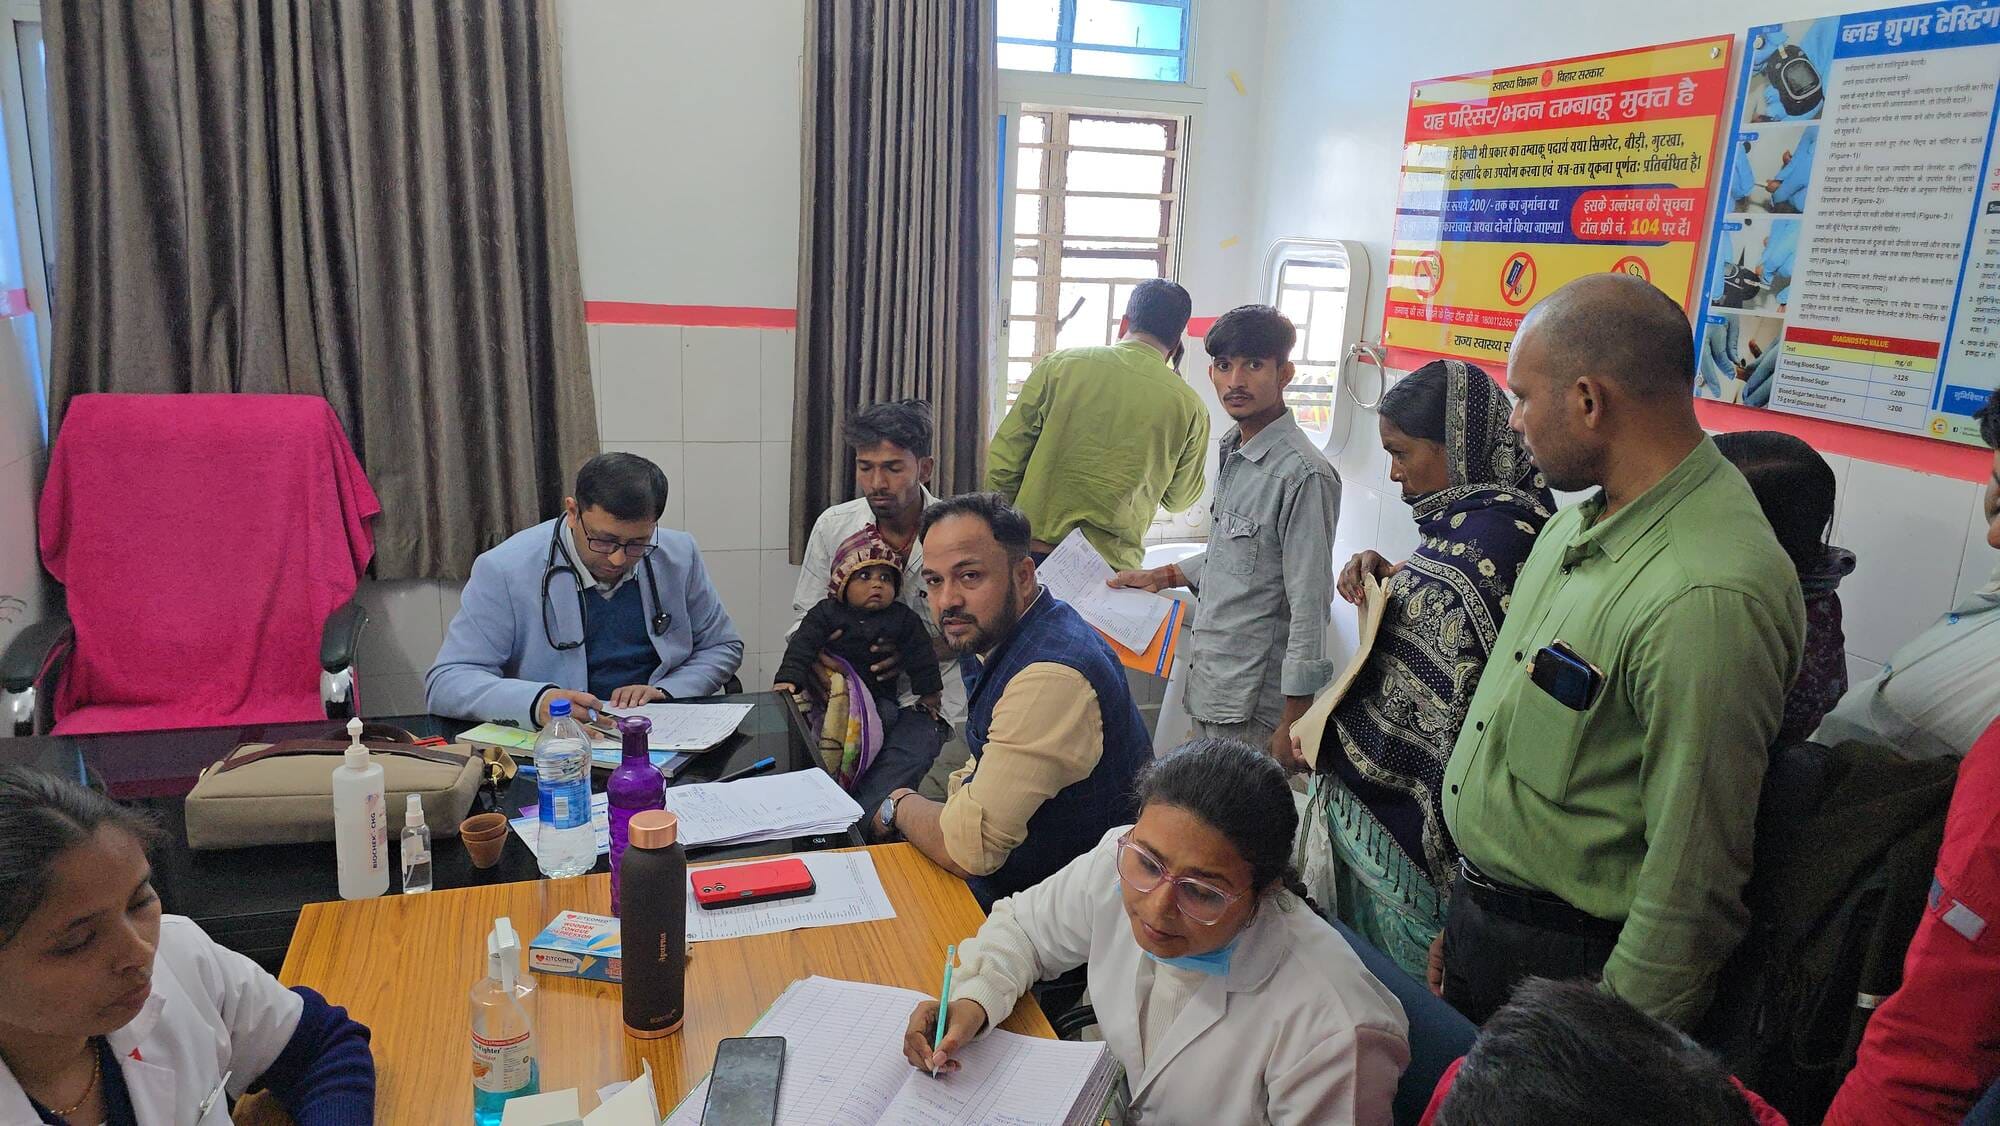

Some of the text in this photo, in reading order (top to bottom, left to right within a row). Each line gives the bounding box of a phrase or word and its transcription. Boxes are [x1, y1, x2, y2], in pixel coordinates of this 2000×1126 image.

[1842, 21, 1882, 44] ब्लड
[1885, 15, 1933, 46] शुगर
[1578, 67, 1605, 80] सरकार
[1492, 75, 1538, 92] स्वास्थ्य विभाग
[1423, 77, 1698, 130] यह परिसर/भवन तम्बाकू मुक्त है
[1460, 145, 1477, 160] किसी
[1480, 144, 1487, 158] भी
[1489, 146, 1508, 158] प्रकार
[1510, 145, 1519, 156] का
[1548, 137, 1568, 154] पदार्थ
[1483, 168, 1492, 179] का
[1494, 164, 1516, 178] उपयोग
[1519, 166, 1540, 177] करना
[1542, 160, 1554, 177] एवं
[1691, 152, 1701, 173] है।
[1470, 198, 1493, 213] 200/-
[1495, 200, 1506, 211] तक
[1508, 200, 1518, 210] का
[1521, 195, 1547, 216] जुर्माना
[1549, 199, 1559, 210] या
[1584, 193, 1695, 216] इसके उल्लंघन की सूचना
[1495, 218, 1512, 233] दोनों
[1514, 218, 1532, 233] किया
[1534, 221, 1564, 234] जाएगा।
[1580, 217, 1690, 236] टॉल फ्री नं. 104 पर दें।
[1454, 335, 1472, 346] राज्य
[1474, 338, 1502, 350] स्वास्थ्य
[1786, 345, 1796, 353] Test
[1832, 335, 1890, 348] DIAGNOSTIC VALUE
[1783, 359, 1830, 371] Fasting Blood Sugar
[1780, 373, 1830, 386] Random Blood Sugar
[1778, 387, 1792, 396] Blood
[1792, 390, 1806, 398] Sugar
[1816, 393, 1829, 402] hours
[1796, 400, 1814, 408] glucose
[564, 922, 595, 930] WOODEN
[576, 916, 608, 924] ZITCOMED
[561, 926, 590, 934] TONGUE
[545, 955, 574, 963] ZITCOMED
